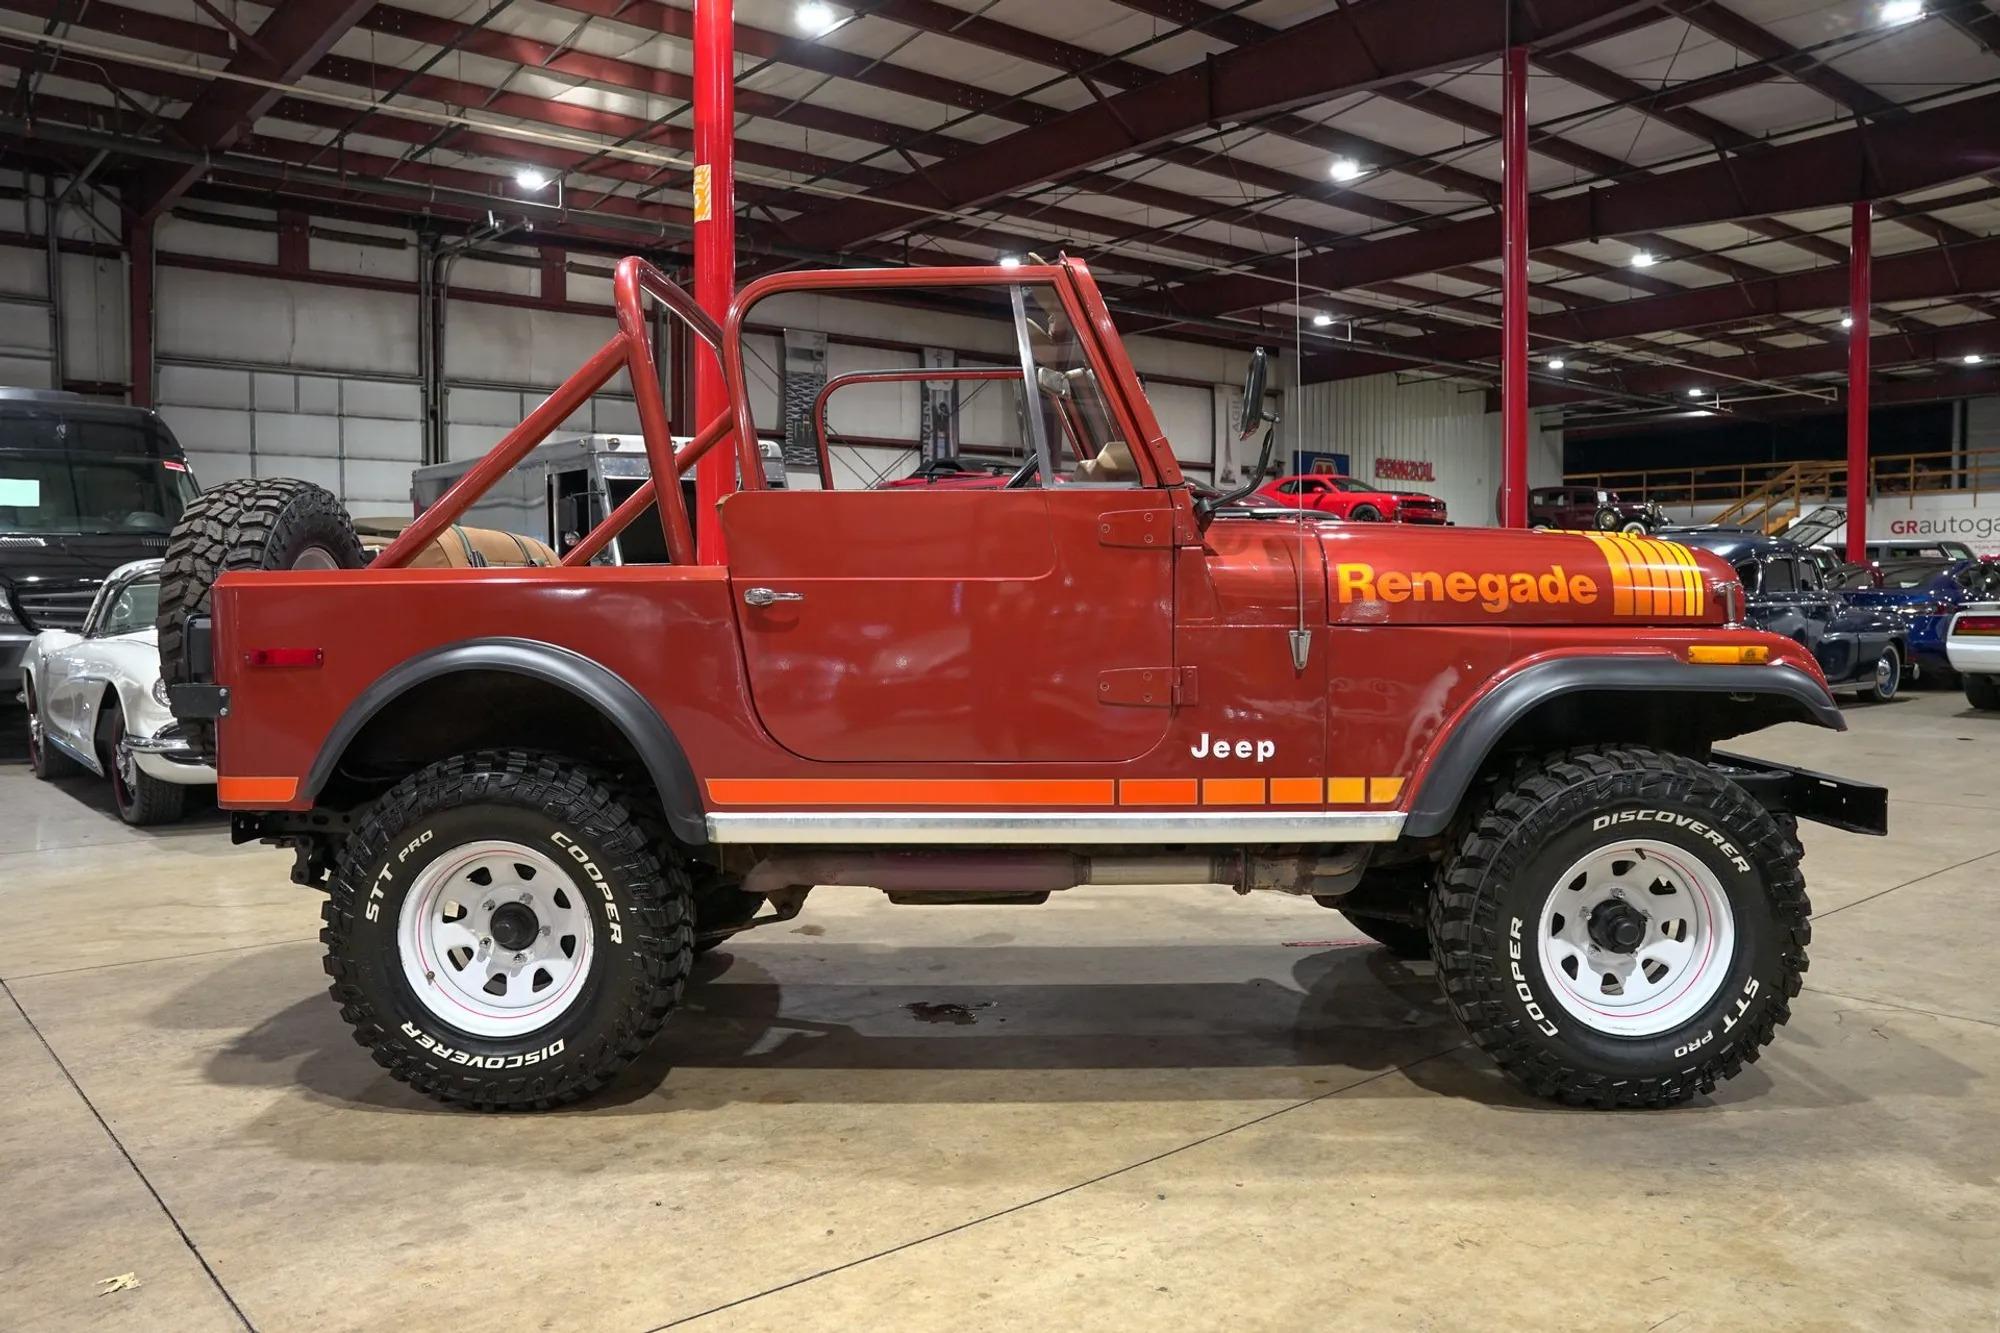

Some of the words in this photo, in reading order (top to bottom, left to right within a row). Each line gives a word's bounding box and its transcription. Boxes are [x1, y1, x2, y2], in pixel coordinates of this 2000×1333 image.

[1375, 458, 1435, 482] PENNZOIL
[1335, 562, 1598, 613] Renegade
[1191, 732, 1275, 763] Jeep
[1593, 809, 1750, 873] DISCOVERER
[366, 862, 393, 923] STT
[398, 829, 434, 863] PRO
[550, 831, 623, 944] COOPER
[1509, 916, 1559, 1037] COOPER
[1723, 975, 1760, 1034] STT
[400, 1020, 565, 1069] DISCOVERER
[1674, 1029, 1714, 1058] PRO
